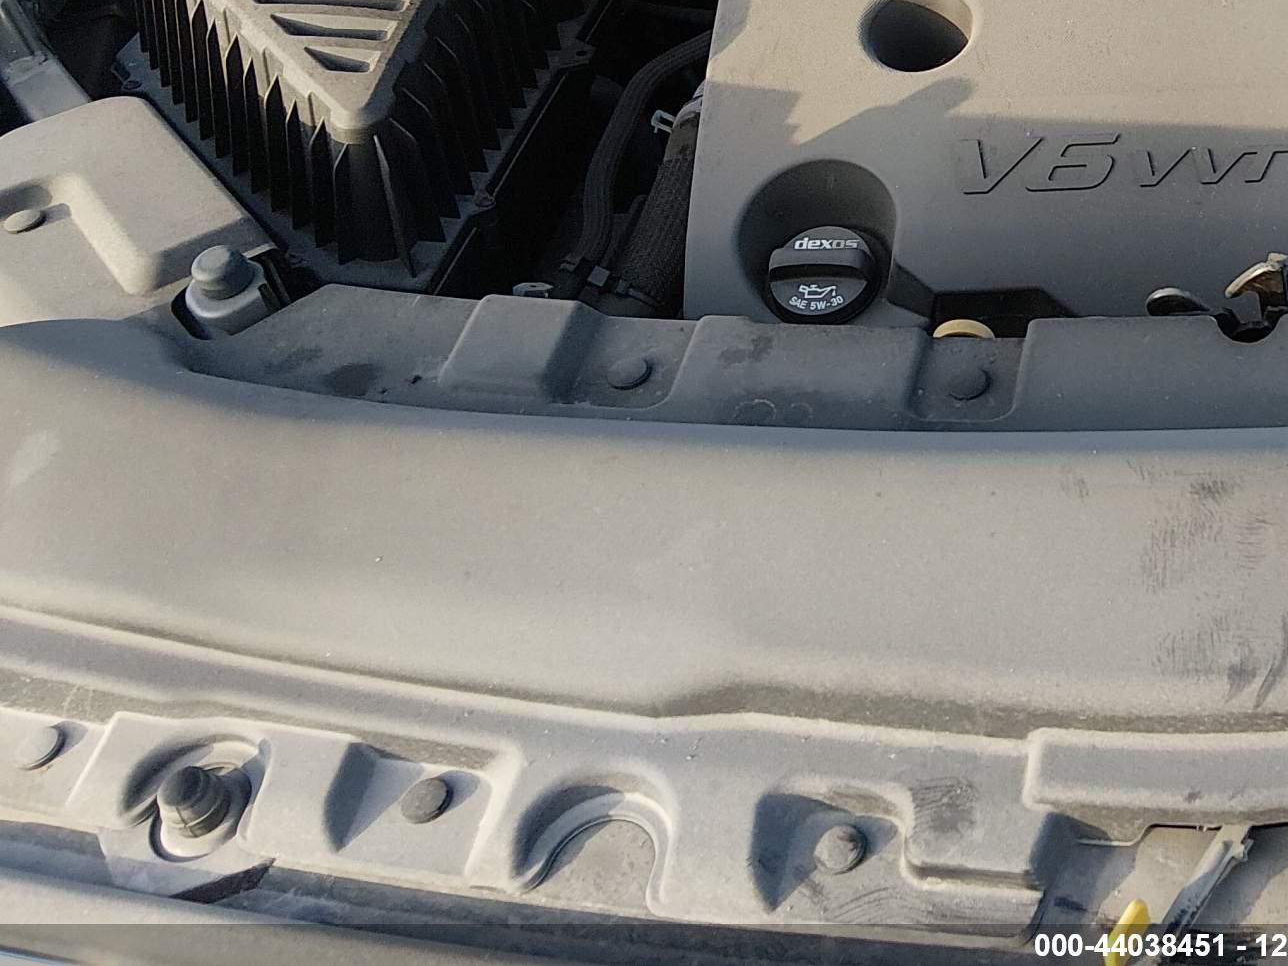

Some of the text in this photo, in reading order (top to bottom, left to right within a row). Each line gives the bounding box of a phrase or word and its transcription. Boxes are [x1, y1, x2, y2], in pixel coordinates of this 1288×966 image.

[960, 132, 1121, 195] V6
[794, 237, 860, 250] dexos
[789, 295, 844, 310] SAE 5W-30
